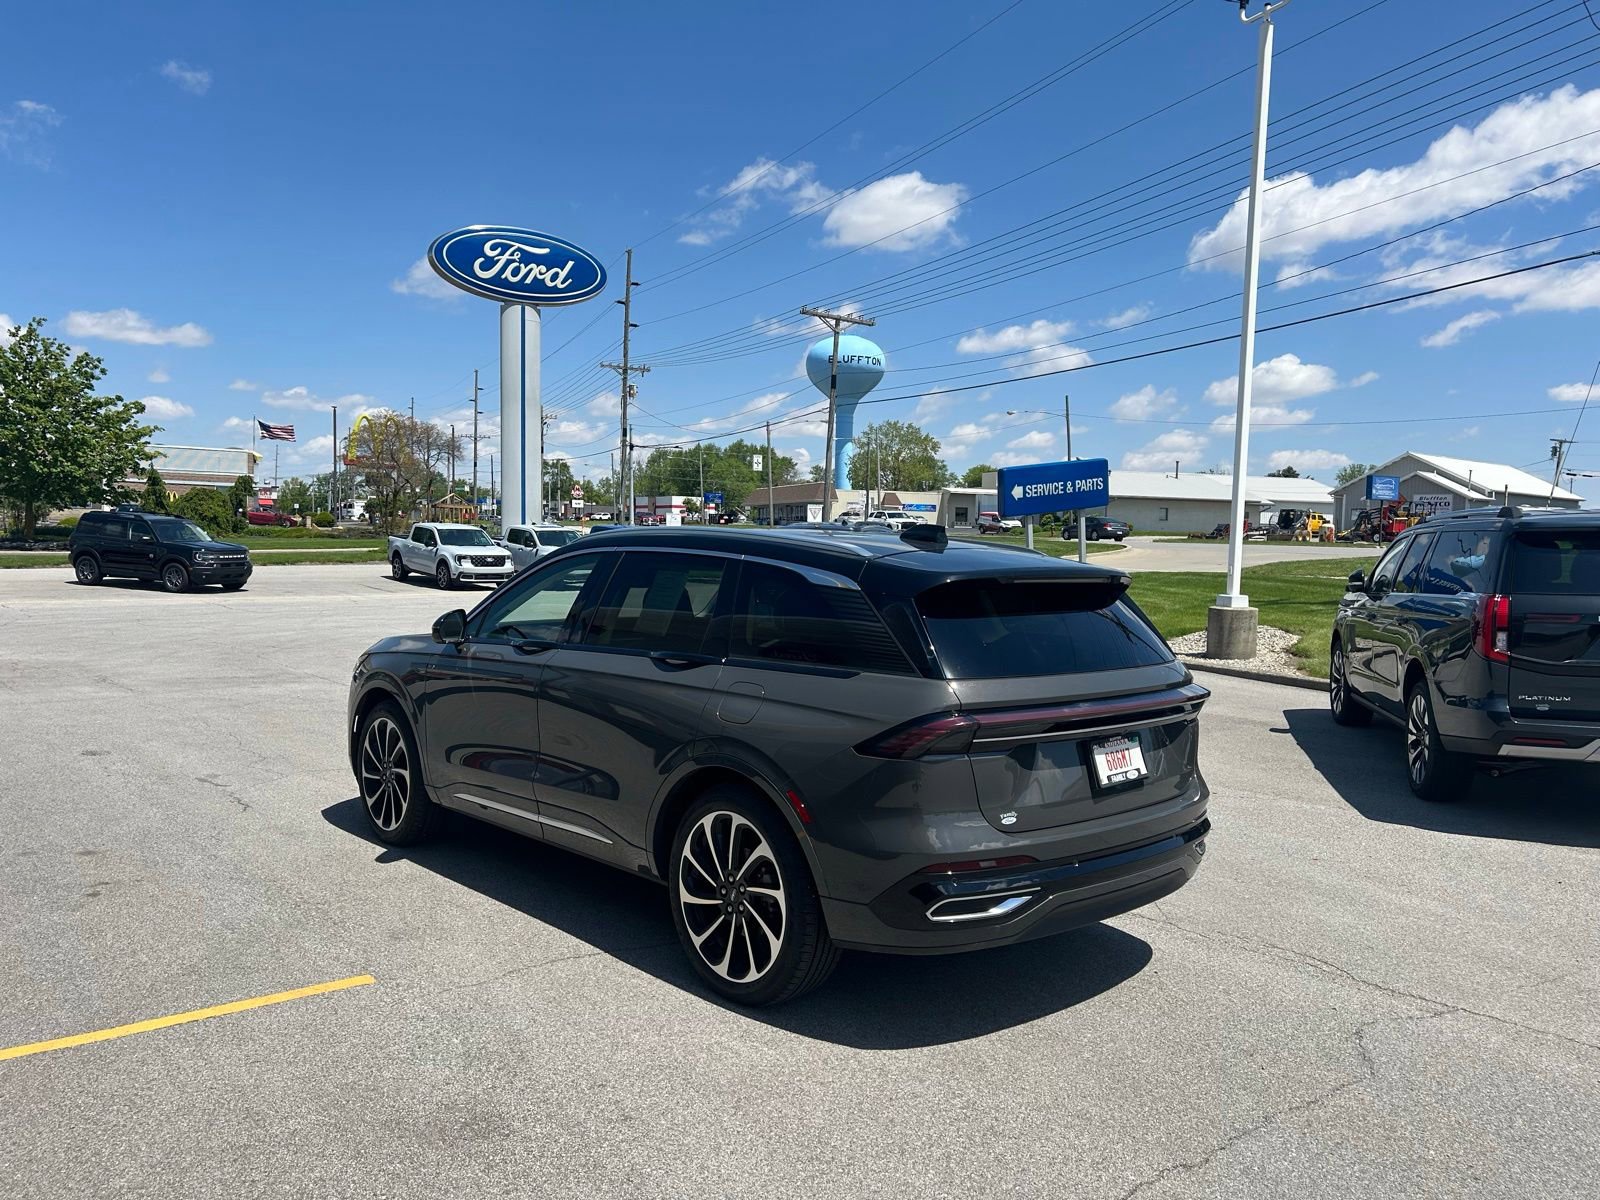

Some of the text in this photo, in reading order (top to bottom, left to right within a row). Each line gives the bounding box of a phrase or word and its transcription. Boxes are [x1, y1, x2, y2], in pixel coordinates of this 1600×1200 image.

[473, 239, 575, 289] Ford
[1026, 477, 1104, 498] SERVICE & PARTS
